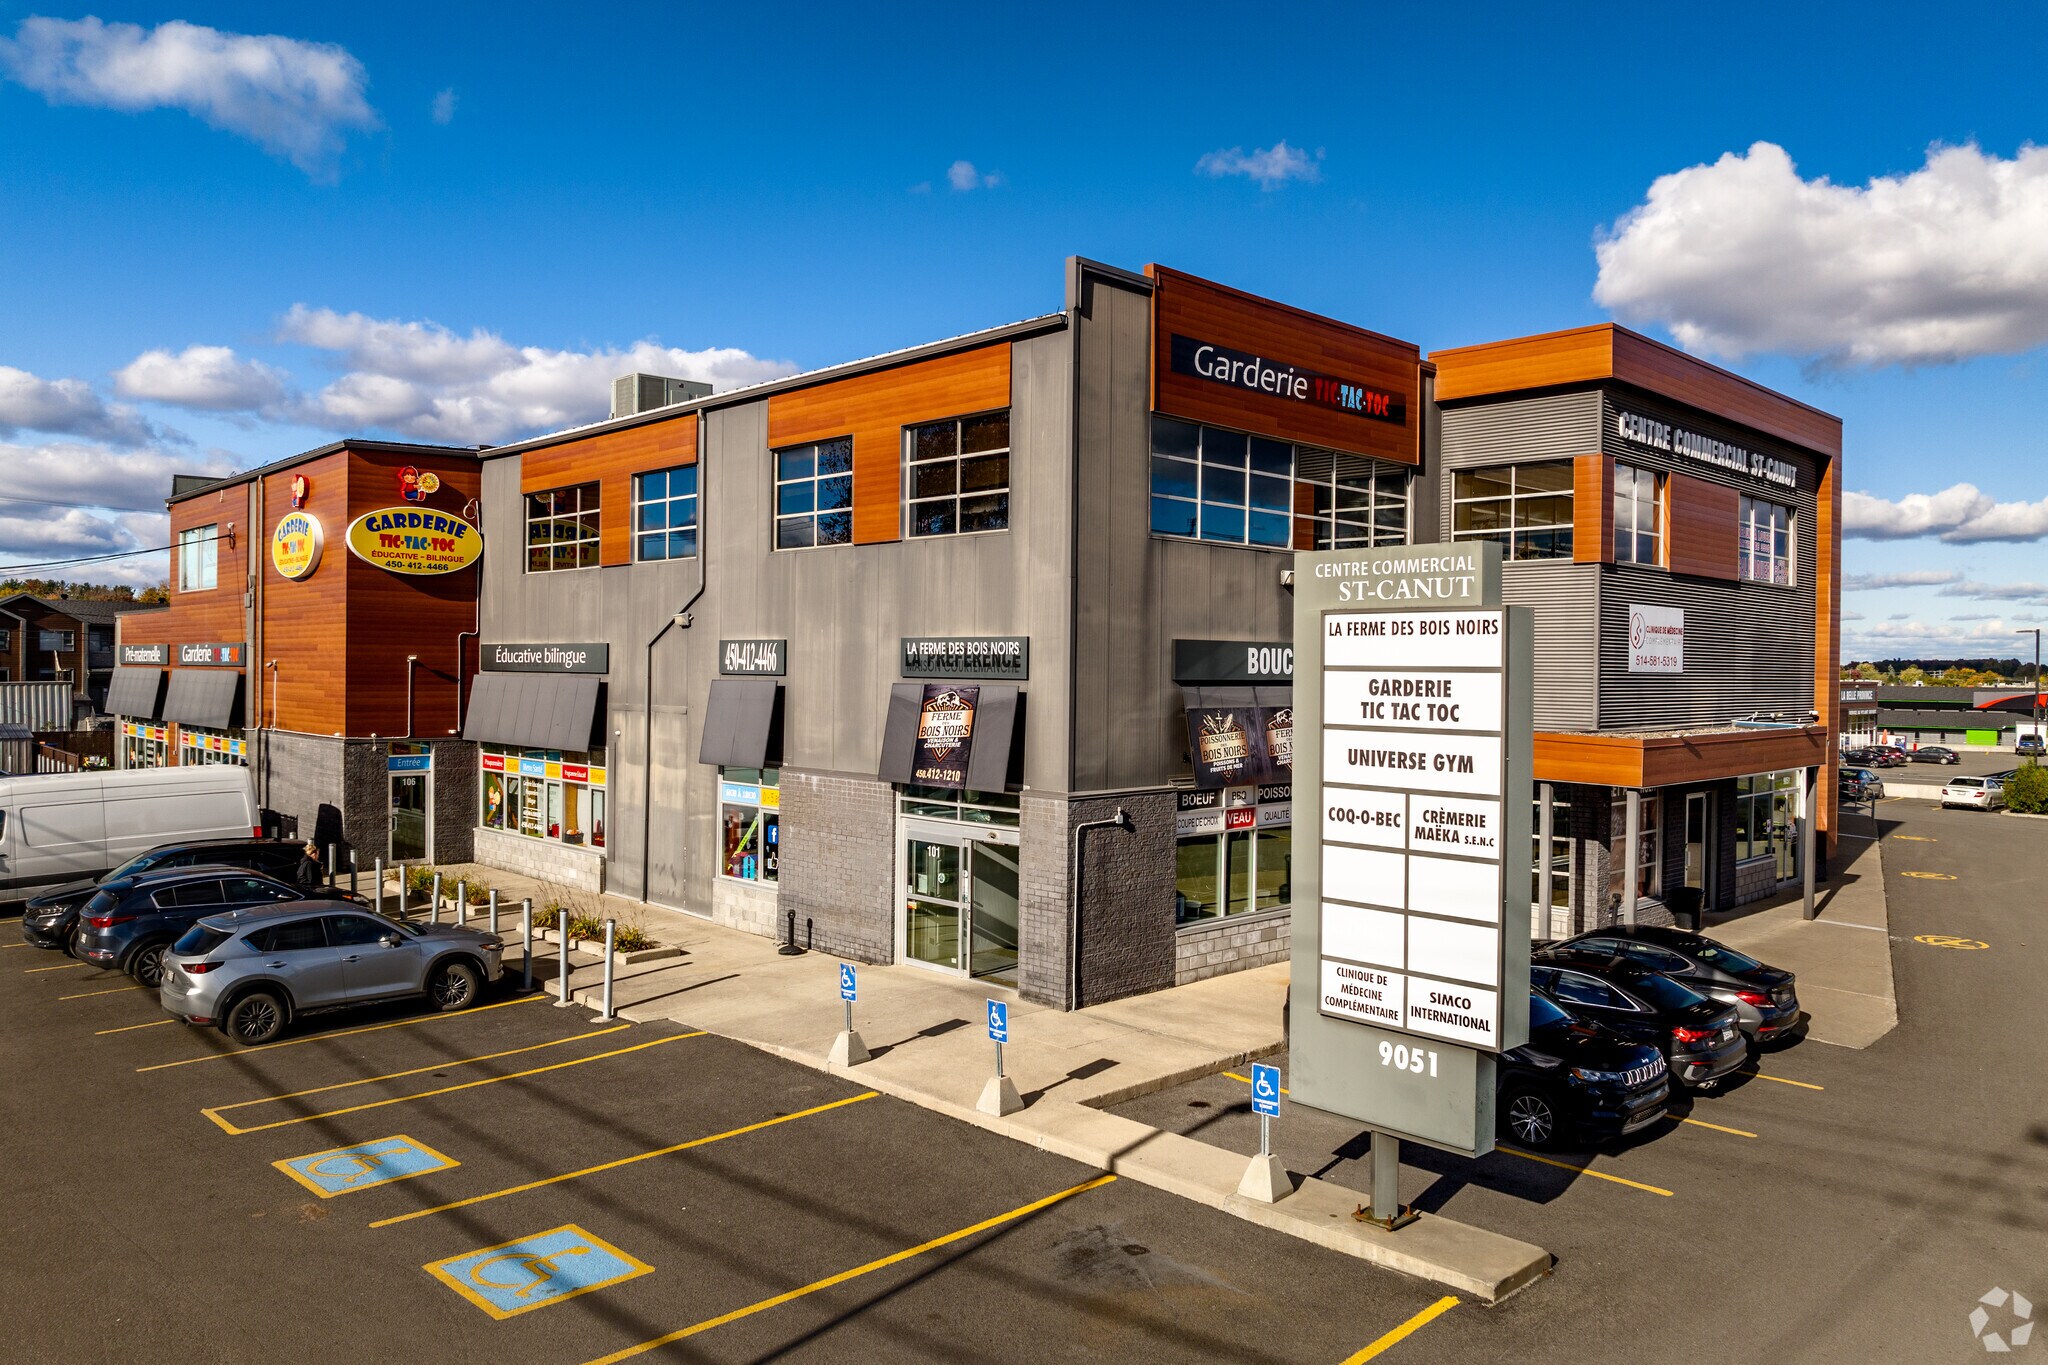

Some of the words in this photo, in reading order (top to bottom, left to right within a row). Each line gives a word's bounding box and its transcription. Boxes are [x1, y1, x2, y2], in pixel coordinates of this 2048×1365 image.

[1194, 345, 1308, 400] Garderie
[1619, 411, 1671, 451] CENTRE
[1674, 428, 1749, 473] COMMERCIAL
[1750, 453, 1797, 488] ST-CANUT
[366, 513, 467, 539] GARDERIE
[372, 550, 418, 560] ÉDUCATIVE
[426, 554, 464, 563] BILINGUE
[1315, 561, 1369, 578] CENTRE
[1372, 556, 1476, 575] COMMERCIAL
[1339, 576, 1475, 602] ST-CANUT
[1329, 622, 1342, 636] LA
[1347, 621, 1386, 636] FERME
[1391, 621, 1414, 635] DES
[1419, 620, 1450, 635] BOIS
[1456, 619, 1499, 635] NOIRS
[125, 645, 161, 662] Pré-maternelle
[182, 644, 211, 662] Garderie
[495, 646, 542, 663] Éducative
[544, 647, 586, 668] bilingue
[725, 643, 778, 671] 450-412-4466
[907, 642, 917, 655] LA
[920, 642, 946, 655] FERME
[948, 642, 965, 655] DES
[967, 642, 988, 655] BOIS
[990, 641, 1020, 655] NOIRS
[1635, 655, 1678, 667] 514-581-5319
[1369, 679, 1452, 698] GARDERIE
[931, 711, 962, 721] FERME
[1361, 702, 1384, 719] TIC
[1391, 703, 1420, 721] TAC
[1427, 703, 1460, 722] TOC
[920, 725, 941, 737] BOIS
[942, 724, 969, 736] NOIRS
[1200, 731, 1245, 745] POISSONNERIE
[1203, 747, 1221, 761] BOIS
[1223, 745, 1247, 759] NOIRS
[1270, 742, 1287, 756] BOIS
[397, 758, 420, 767] Entrée
[1348, 749, 1427, 770] UNIVERSE
[1434, 754, 1474, 774] GYM
[402, 778, 416, 786] 106
[1182, 792, 1215, 806] BOEUF
[1232, 791, 1247, 801] BBQ
[1259, 786, 1292, 800] POISSO
[1178, 817, 1195, 829] COUPE
[1196, 817, 1203, 826] DE
[1203, 815, 1219, 826] CHOIX
[1227, 811, 1252, 825] VEAU
[1264, 807, 1290, 821] QUALITÉ
[1328, 807, 1400, 828] COQ-O-BEC
[1423, 807, 1486, 828] CRÈMERIE
[1415, 825, 1460, 843] MAËKA
[1465, 836, 1494, 847] S.E.N.C
[927, 845, 940, 858] 101
[1336, 967, 1374, 983] CLINIQUE
[1377, 974, 1388, 986] DE
[1341, 983, 1383, 1001] MÉDECINE
[1430, 992, 1471, 1010] SIMCO
[1325, 995, 1399, 1021] COMPLÉMENTAIRE
[1411, 1005, 1491, 1032] INTERNATIONAL
[1378, 1040, 1438, 1078] 9051
